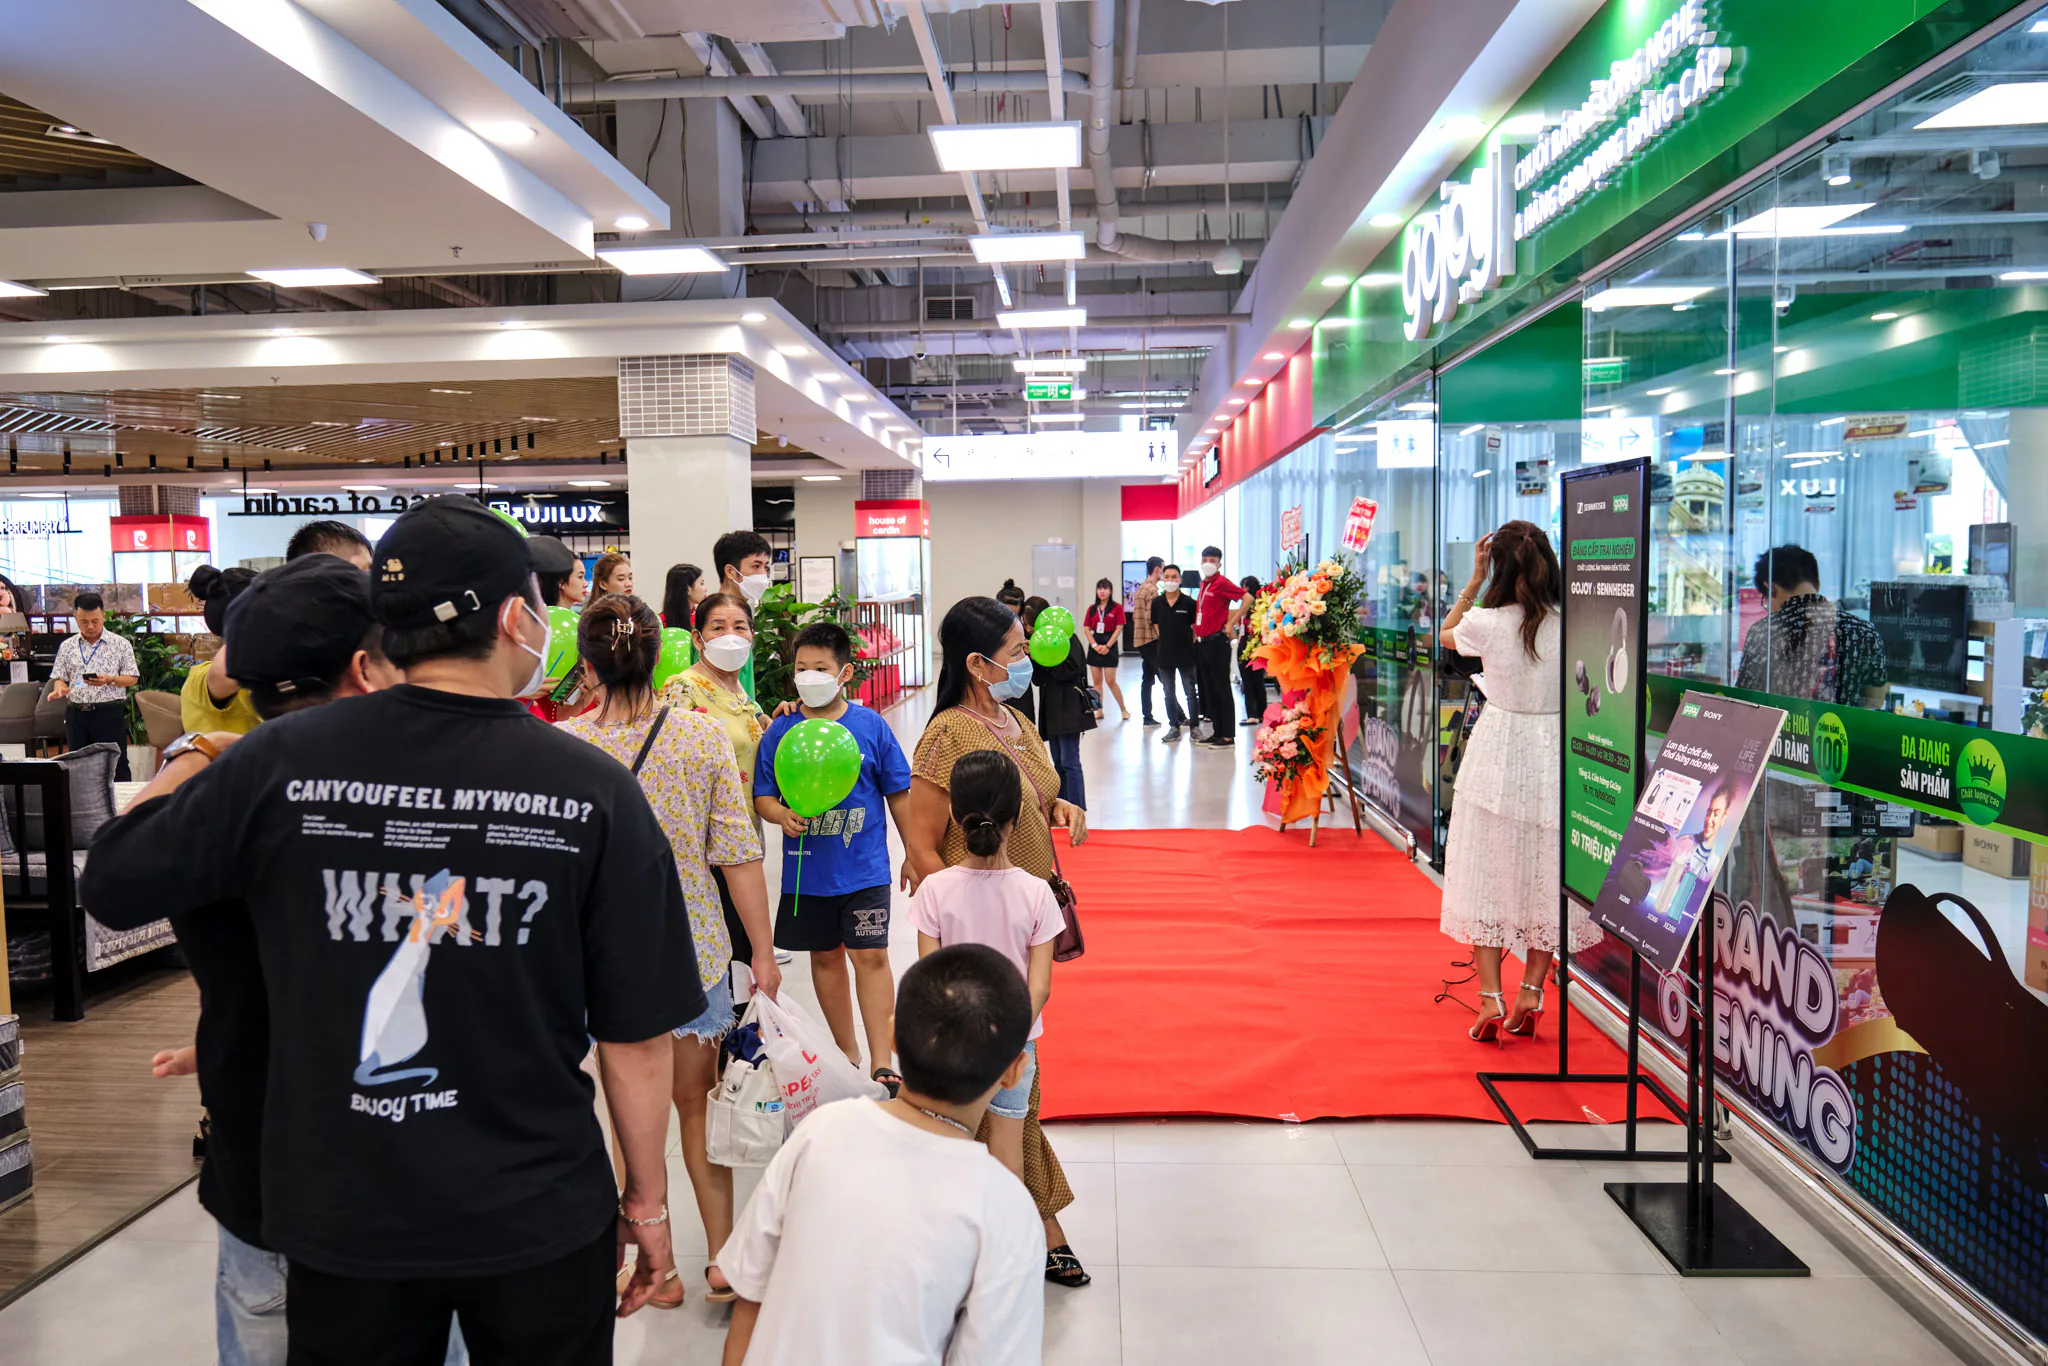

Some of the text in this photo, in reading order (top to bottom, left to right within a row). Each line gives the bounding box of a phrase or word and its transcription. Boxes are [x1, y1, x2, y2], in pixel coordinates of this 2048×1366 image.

[1679, 31, 1730, 109] CẤP
[511, 505, 604, 523] FUJILUX
[868, 515, 906, 525] house of
[872, 526, 901, 535] cardin
[1571, 581, 1592, 595] GOJOY
[1596, 582, 1634, 597] SENNHEISER
[1703, 710, 1723, 721] SONY
[1792, 710, 1810, 736] HOÁ
[1365, 719, 1397, 769] GRAND
[1666, 740, 1678, 750] Lan
[1739, 749, 1757, 763] LIFE
[1784, 734, 1809, 764] RÀNG
[1901, 733, 1950, 769] ĐA DẠNG
[1900, 766, 1950, 800] SẢN PHẨM
[286, 780, 594, 823] CANYOUFEEL MYWORLD?
[1989, 795, 2000, 808] cao
[1571, 828, 1580, 848] 50
[1581, 833, 1604, 861] TRIỆU
[1973, 837, 2000, 854] SONY
[853, 908, 888, 931] XP
[1713, 893, 1834, 1034] RAND
[1660, 970, 1852, 1165] OENING
[410, 1089, 458, 1113] TIME
